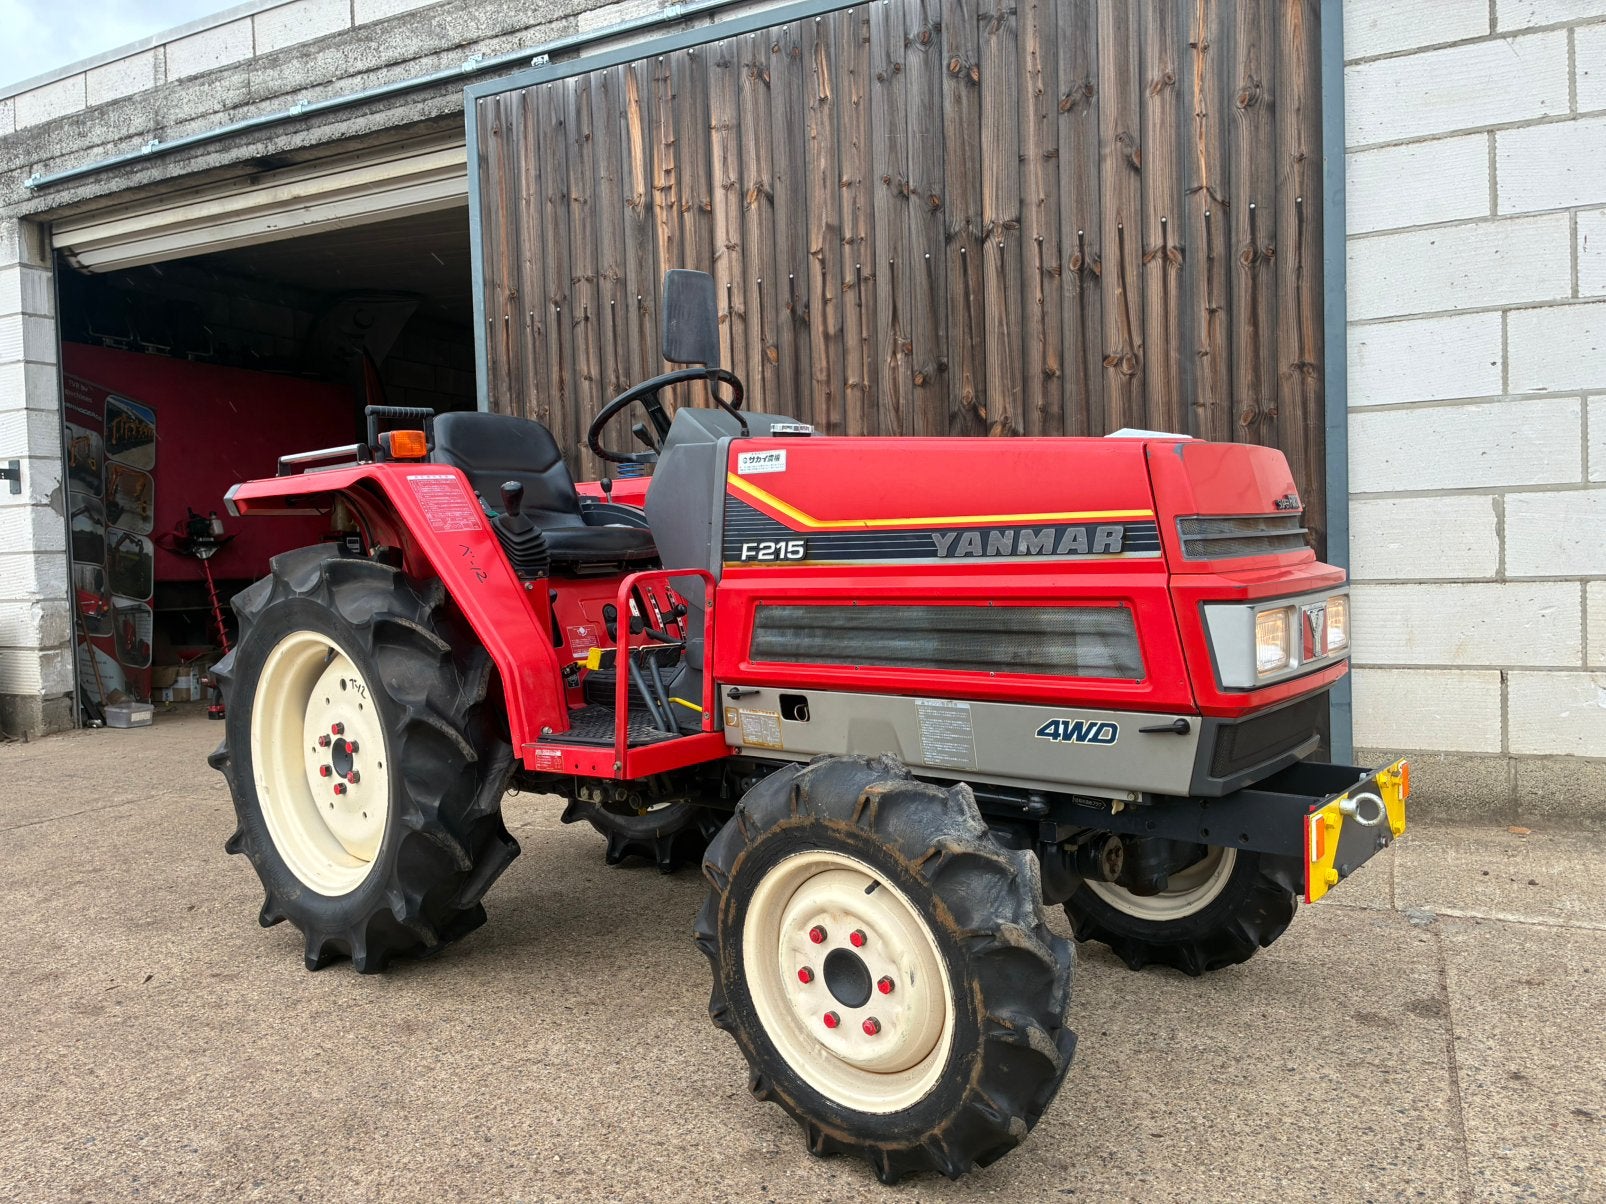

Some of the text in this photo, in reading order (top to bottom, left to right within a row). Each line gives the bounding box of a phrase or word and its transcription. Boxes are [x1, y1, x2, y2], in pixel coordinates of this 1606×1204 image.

[741, 540, 805, 561] F215
[931, 525, 1125, 558] YANMAR
[1035, 718, 1120, 746] 4WD
